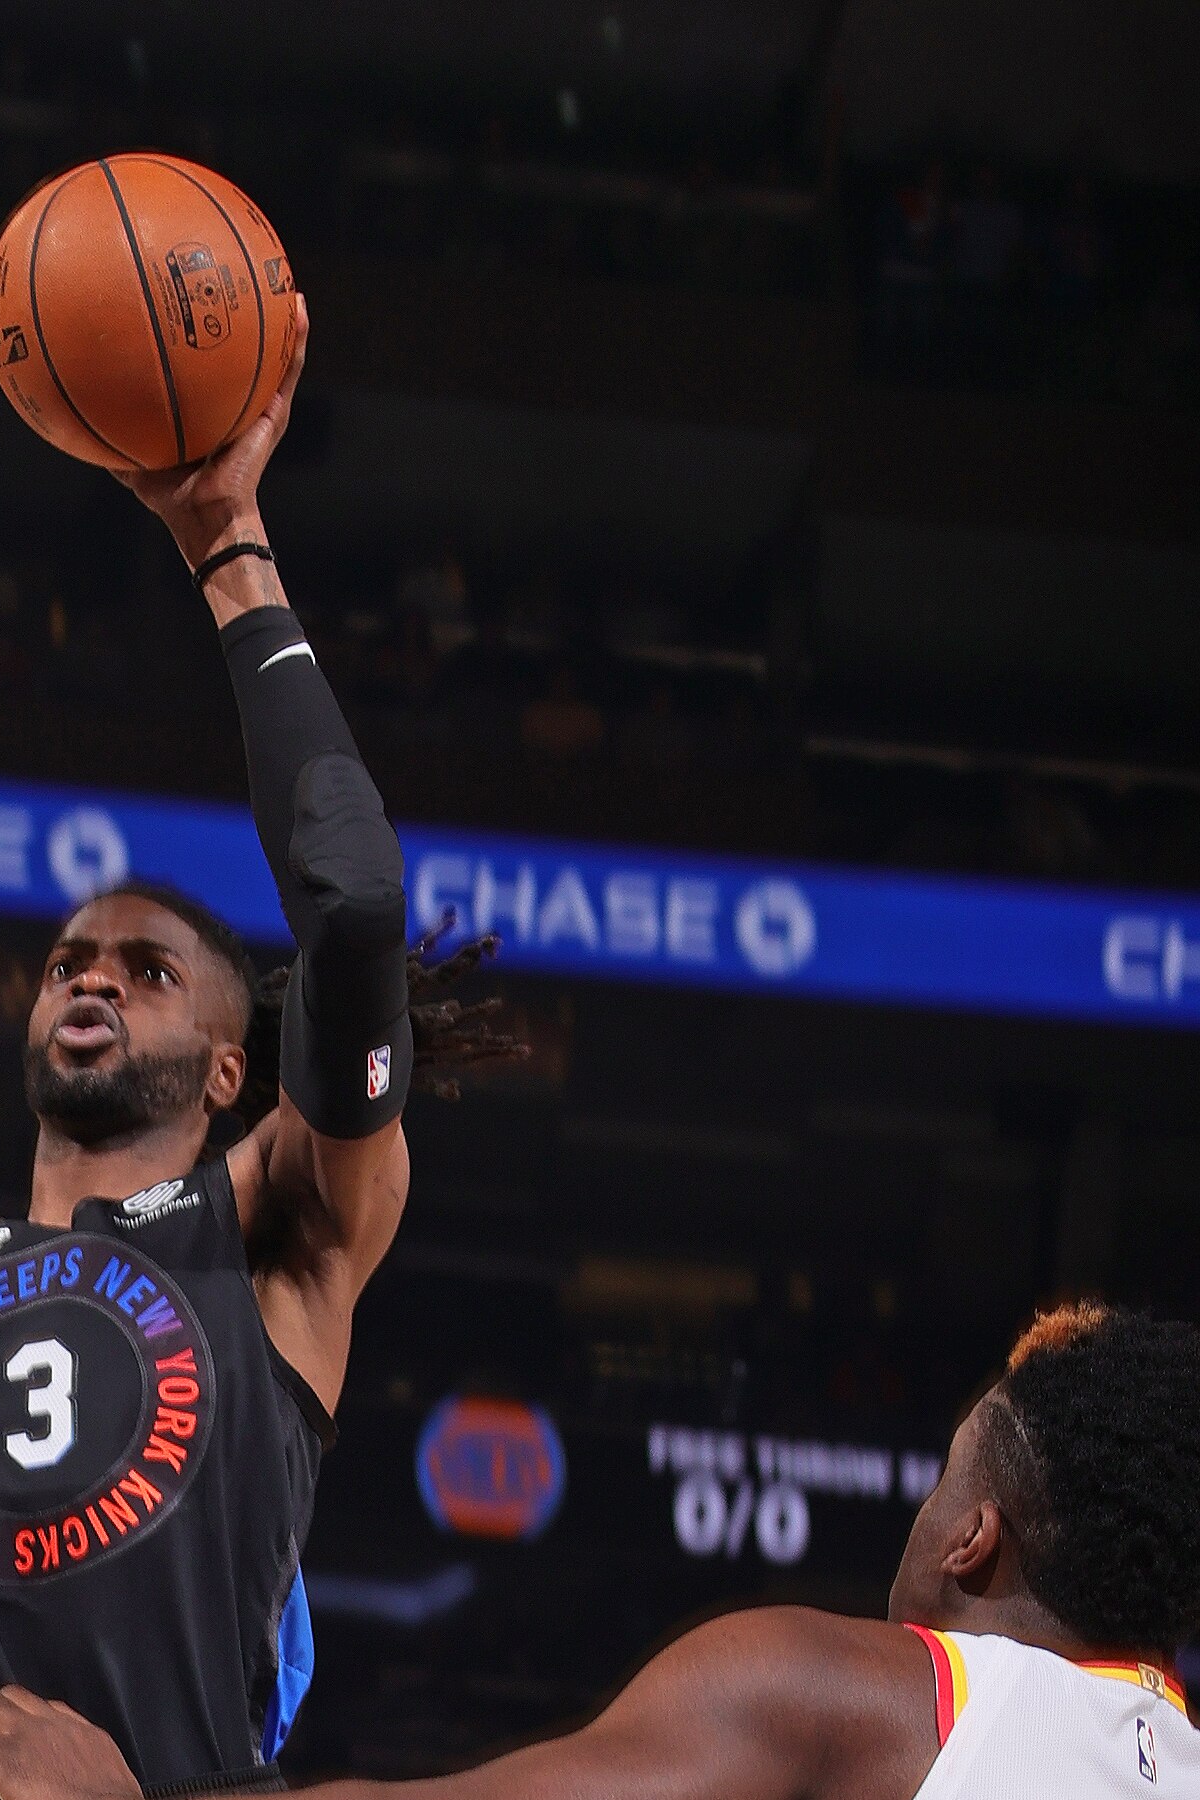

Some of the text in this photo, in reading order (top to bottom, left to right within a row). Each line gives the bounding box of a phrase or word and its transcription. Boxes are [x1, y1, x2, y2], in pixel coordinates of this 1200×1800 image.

[414, 850, 721, 967] CHASE
[93, 1256, 183, 1339] NEW
[4, 1337, 78, 1471] 3
[142, 1346, 200, 1476] YORK
[12, 1468, 163, 1575] KNICKS
[673, 1471, 811, 1565] 0/0
